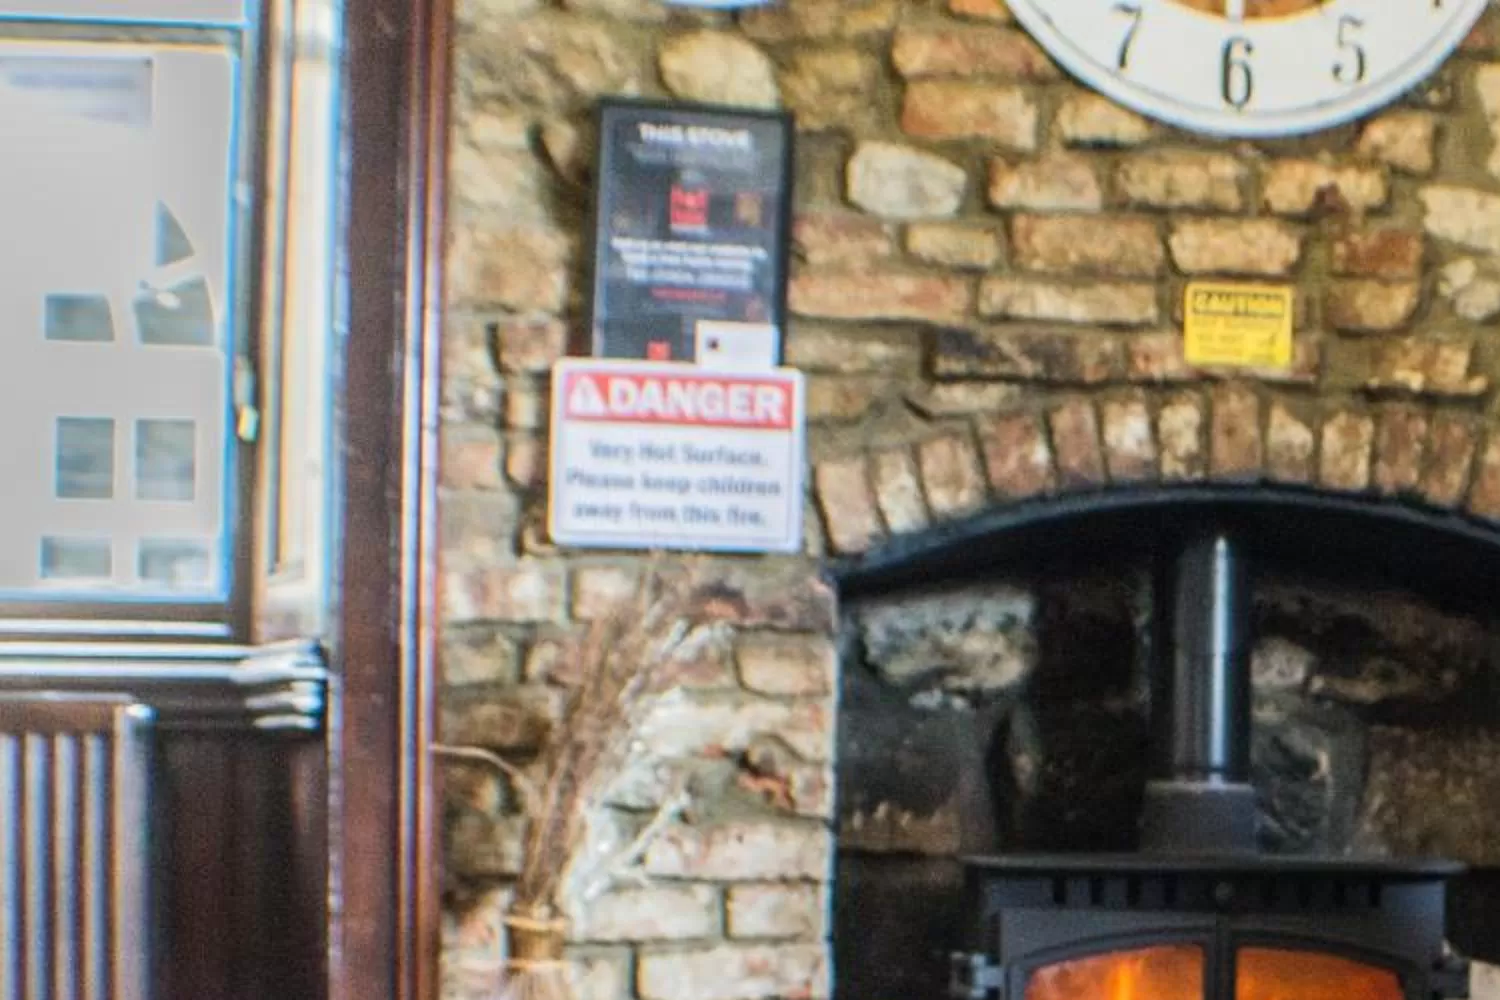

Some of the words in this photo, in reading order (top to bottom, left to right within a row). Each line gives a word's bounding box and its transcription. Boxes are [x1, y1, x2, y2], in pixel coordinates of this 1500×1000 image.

[1111, 3, 1141, 69] 7
[1331, 15, 1367, 83] 5
[1220, 36, 1254, 110] 6
[609, 377, 785, 422] DANGER
[589, 440, 635, 464] Very
[639, 441, 675, 463] Hot
[566, 468, 634, 489] Please
[641, 471, 691, 495] keep
[696, 474, 781, 495] children
[573, 504, 623, 525] away
[629, 501, 676, 522] from
[682, 504, 720, 525] this
